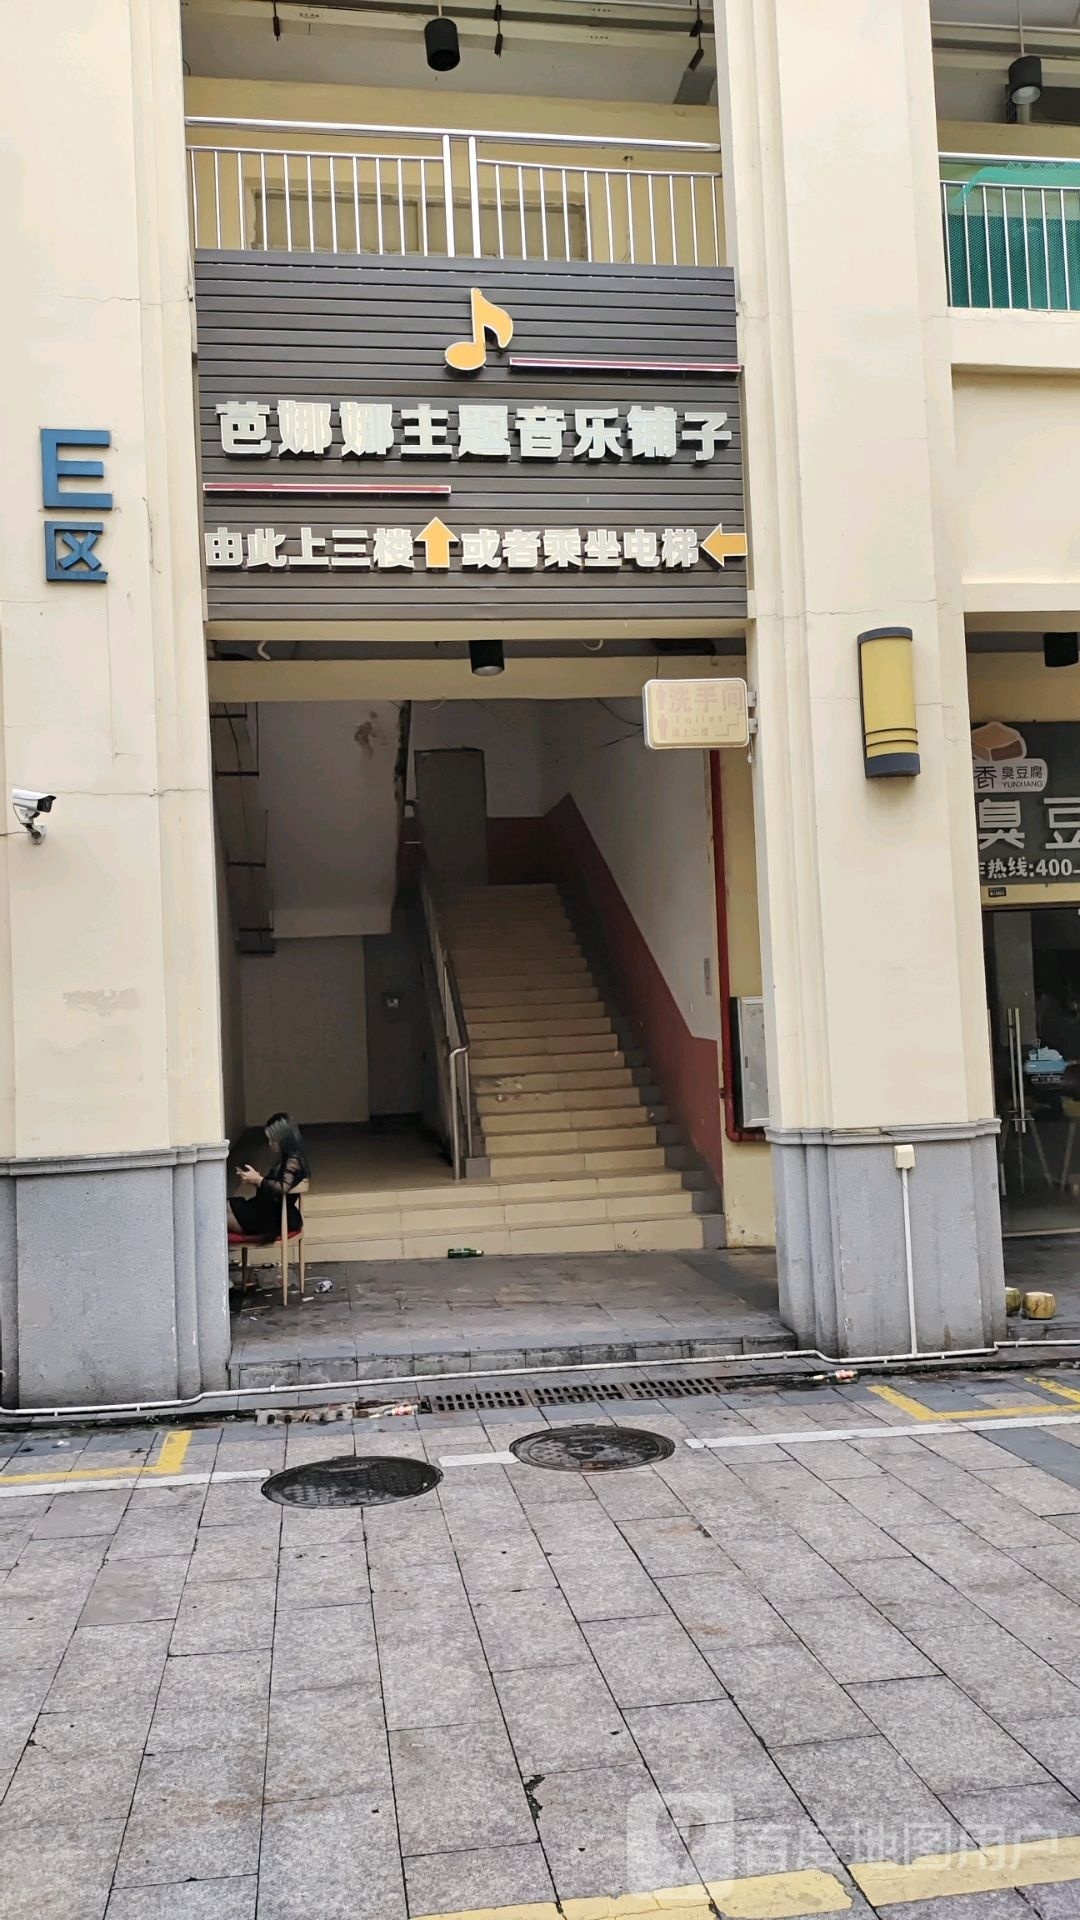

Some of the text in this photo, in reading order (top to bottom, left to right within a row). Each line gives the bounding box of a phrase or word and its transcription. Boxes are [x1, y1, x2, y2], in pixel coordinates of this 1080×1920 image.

[216, 400, 732, 461] 芭娜娜主题音乐铺子
[40, 428, 113, 584] E区
[204, 527, 700, 570] 由此上三楼 或者乘坐电梯
[669, 685, 744, 713] 洗手间
[673, 715, 724, 724] Toilet
[974, 765, 1043, 790] 香 臭豆腐
[1002, 780, 1044, 789] YUNXIANG
[977, 797, 1080, 851] 臭豆
